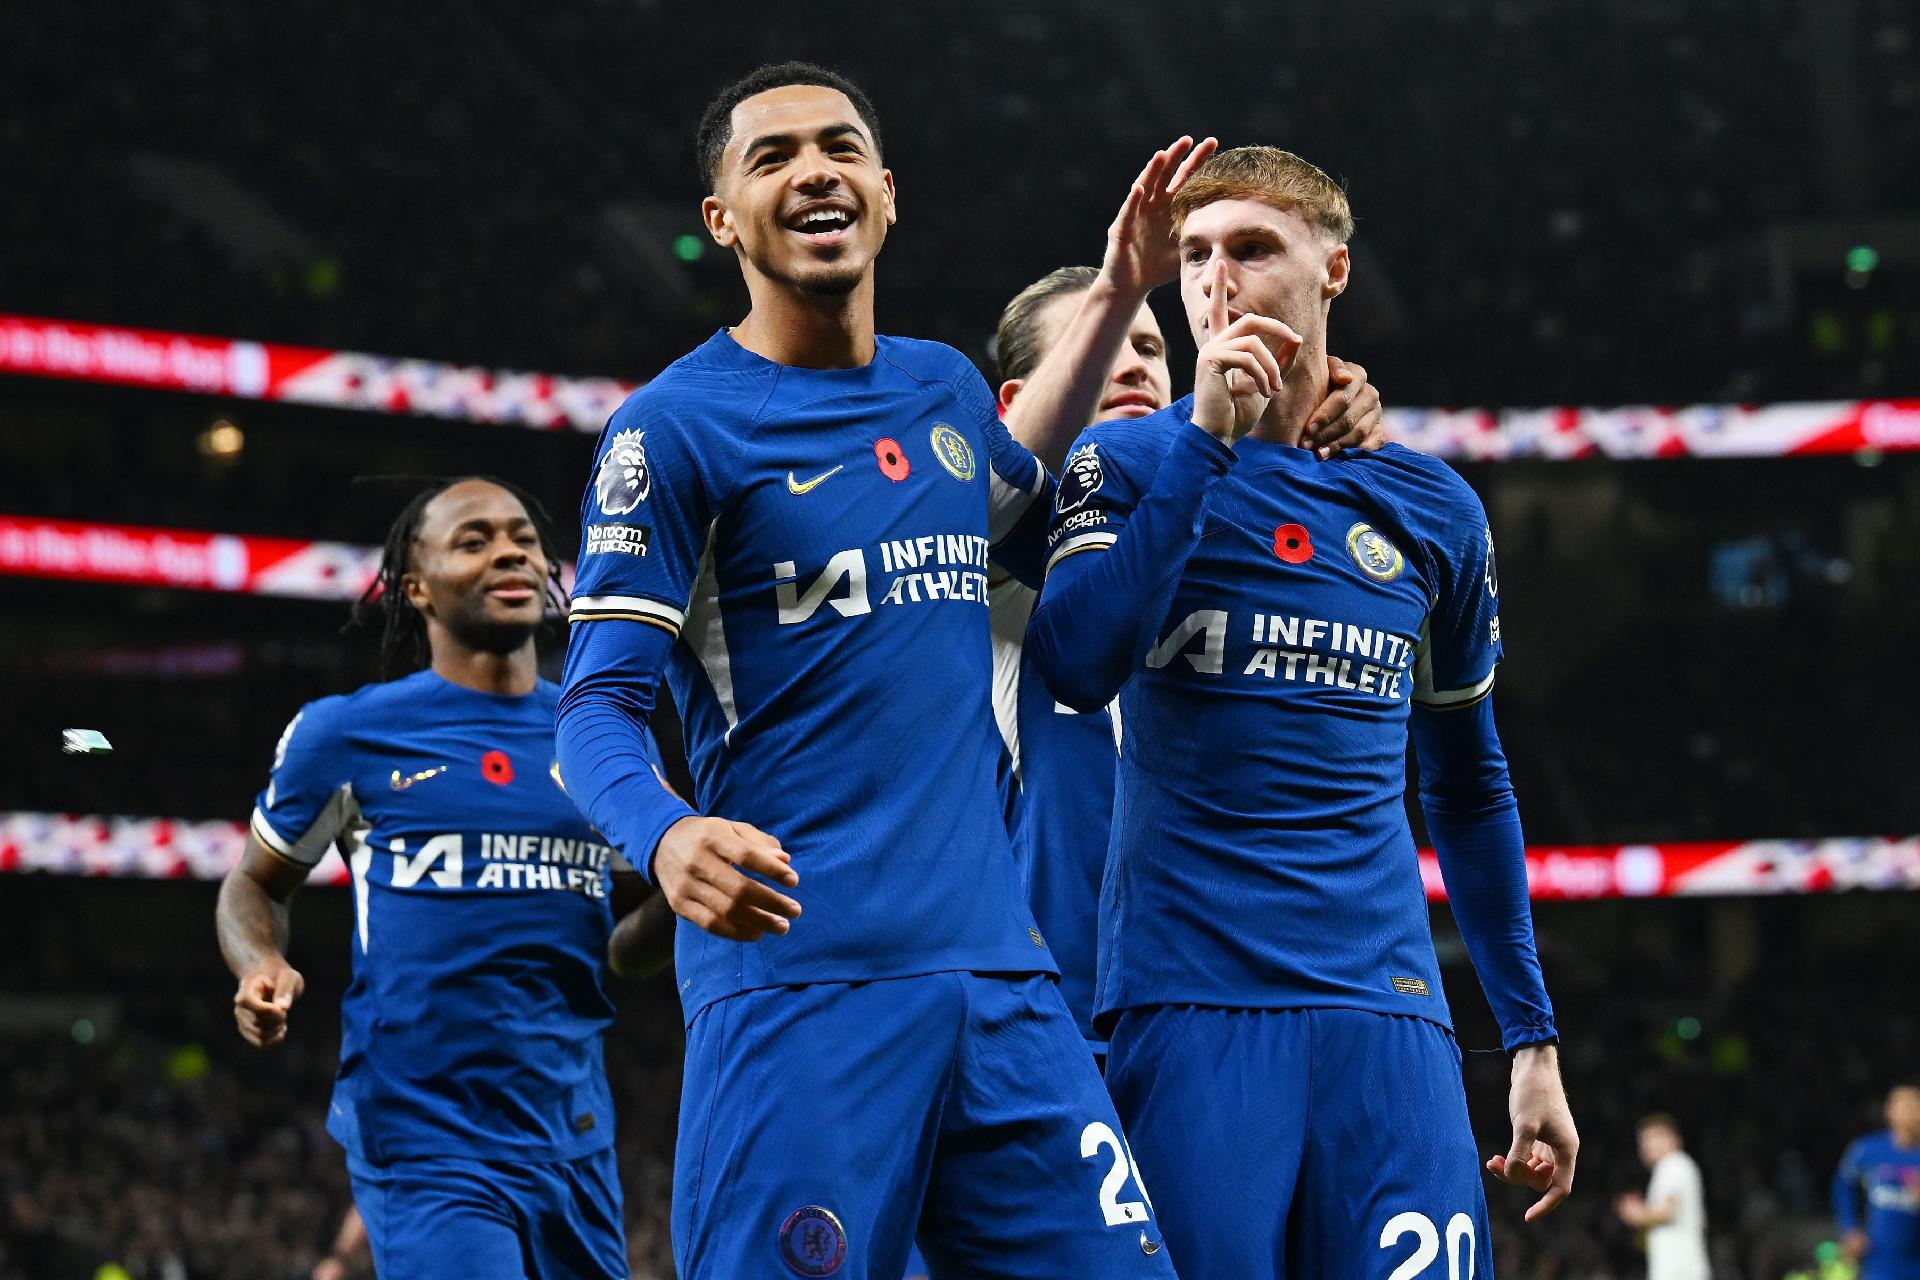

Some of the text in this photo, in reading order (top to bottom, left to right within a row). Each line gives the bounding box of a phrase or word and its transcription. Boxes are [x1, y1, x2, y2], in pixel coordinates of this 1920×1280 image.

[587, 525, 642, 541] No room
[601, 540, 647, 556] racism
[1048, 529, 1063, 547] No
[1252, 613, 1412, 668] INFINITE
[1243, 649, 1401, 699] ATHLETE
[481, 833, 610, 869] INFINITE
[476, 862, 606, 898] ATHLETE
[1080, 1121, 1154, 1226] 2
[1380, 1211, 1476, 1280] 20
